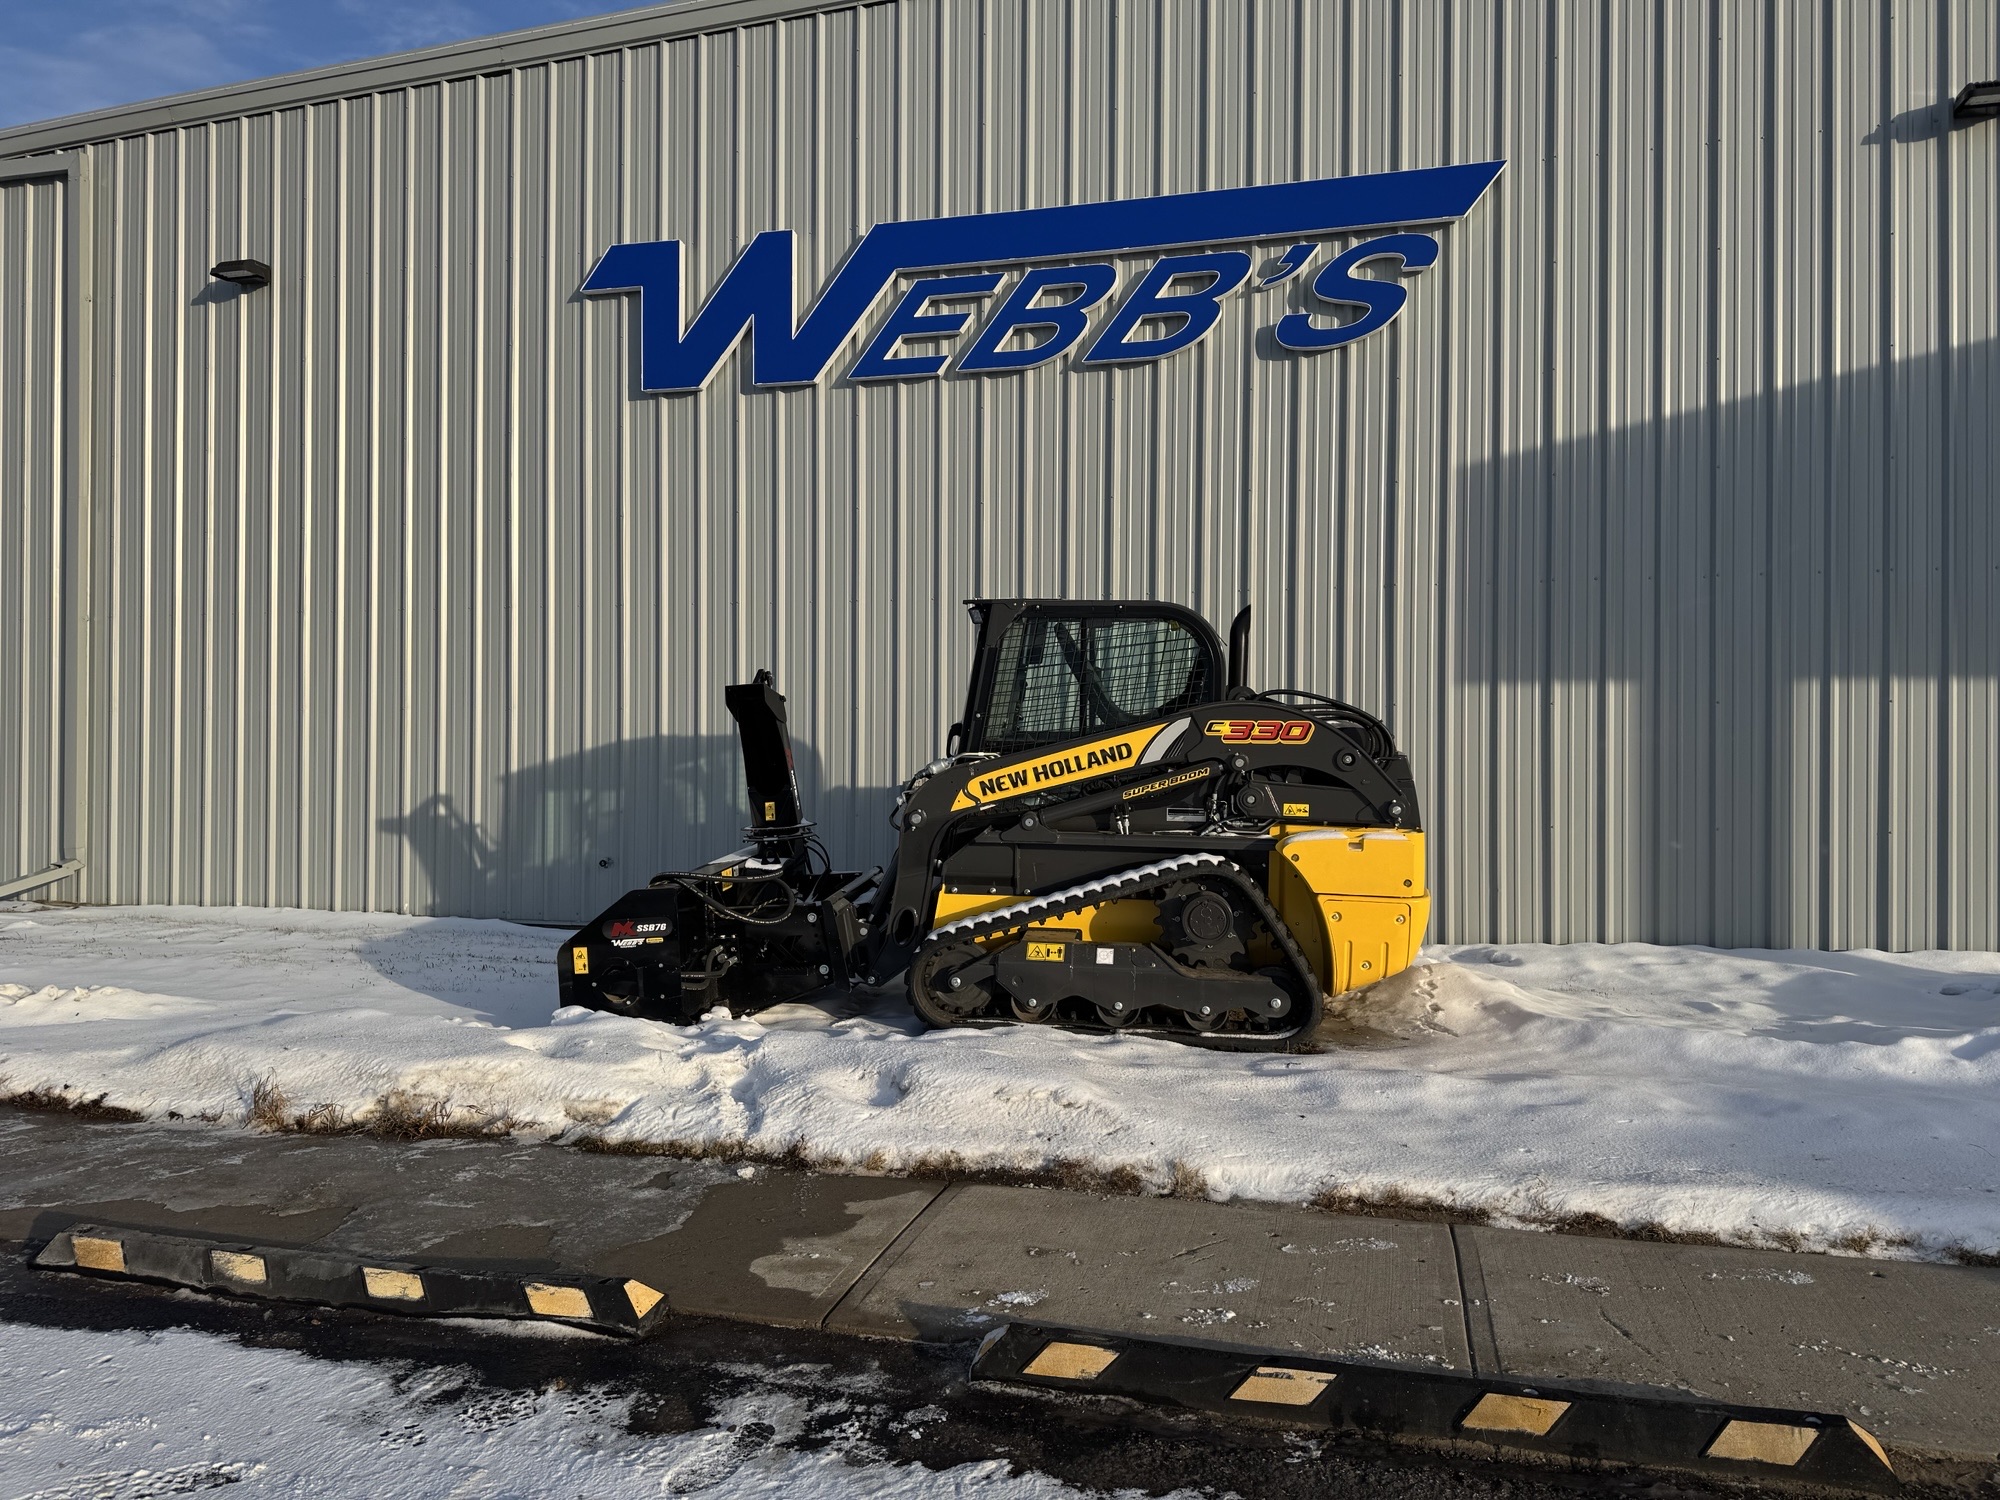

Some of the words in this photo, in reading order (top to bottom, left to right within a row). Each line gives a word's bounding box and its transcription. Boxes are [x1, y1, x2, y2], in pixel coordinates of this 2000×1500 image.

[581, 159, 1507, 394] WEBB'S
[1204, 720, 1315, 744] C330
[979, 765, 1029, 797] NEW
[1033, 743, 1133, 784] HOLLAND
[1122, 779, 1169, 800] SUPER
[1169, 767, 1210, 786] BOOM
